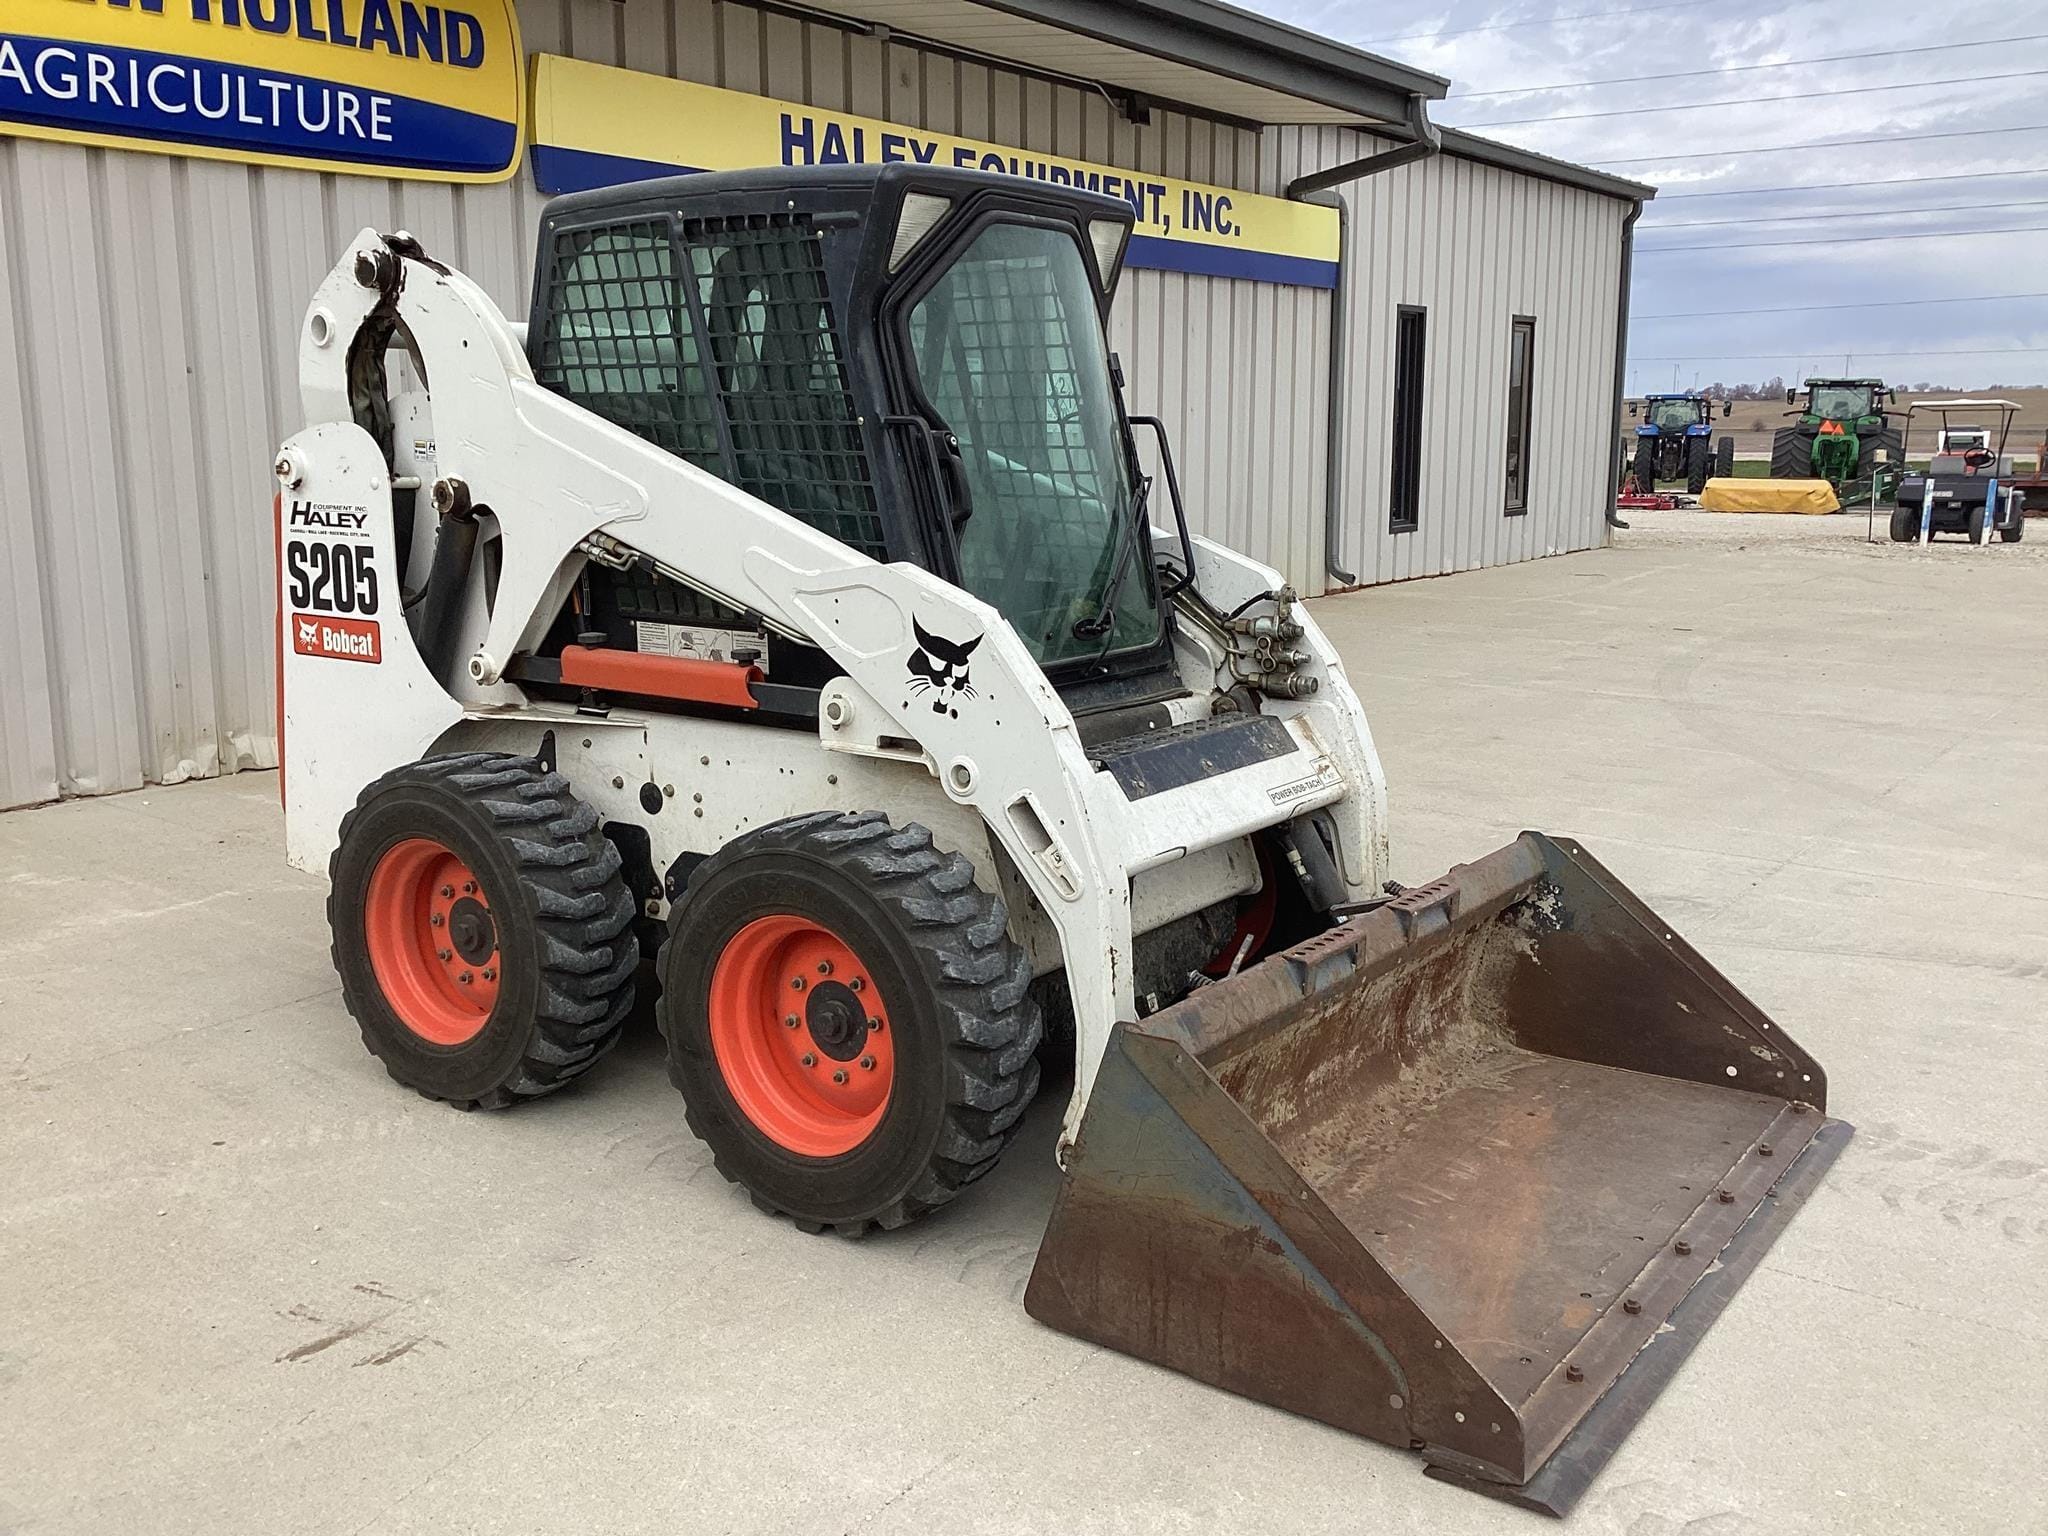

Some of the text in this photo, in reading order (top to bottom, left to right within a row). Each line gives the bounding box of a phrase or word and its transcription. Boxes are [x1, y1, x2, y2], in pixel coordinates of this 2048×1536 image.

[0, 40, 393, 142] AGRICULTURE
[1182, 189, 1241, 237] INC.
[290, 500, 368, 529] HALEY
[313, 503, 353, 512] EQUIPMENT
[287, 540, 379, 616] S205
[322, 626, 375, 657] Bobcat
[1270, 778, 1322, 801] POWER BOB-TACH
